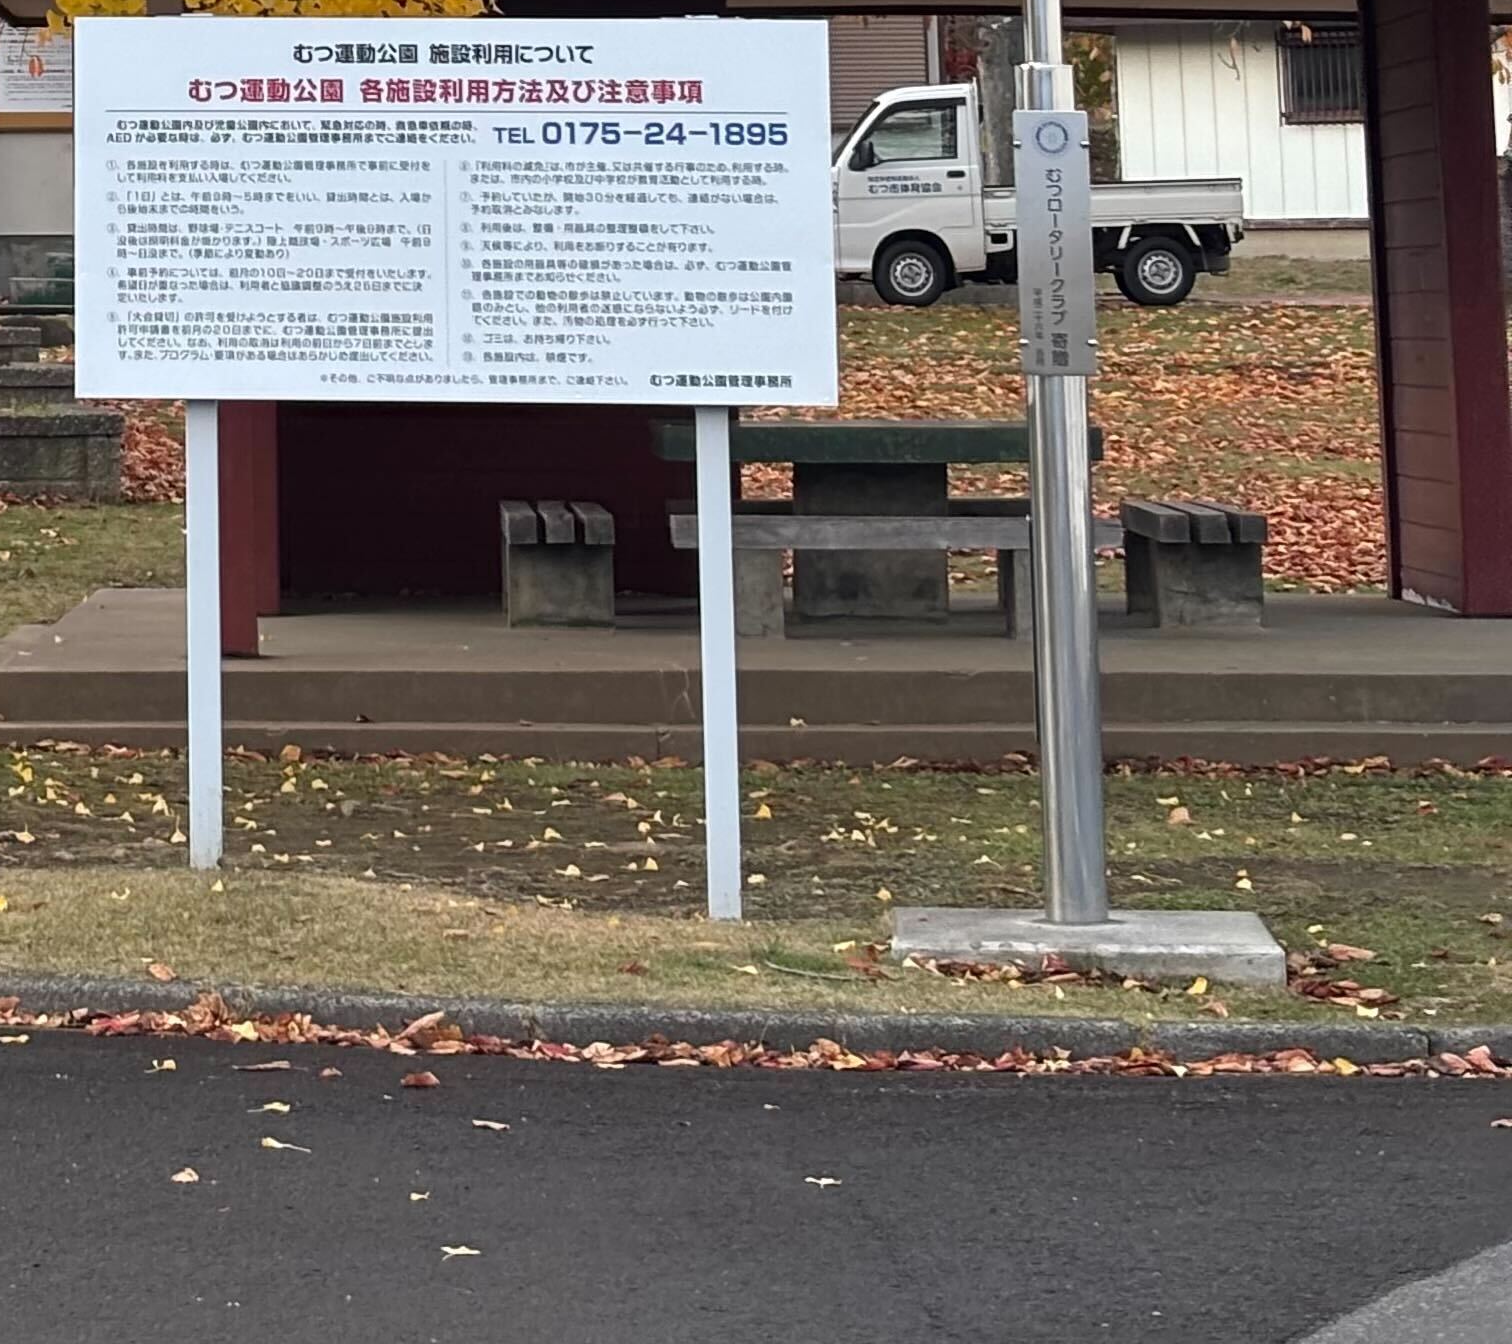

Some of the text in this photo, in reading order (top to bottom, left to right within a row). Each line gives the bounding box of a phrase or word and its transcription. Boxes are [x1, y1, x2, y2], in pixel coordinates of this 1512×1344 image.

[293, 43, 594, 64] むつ運動公園 施設利用について
[189, 78, 703, 104] むつ運動公園 各施設利用方法及び注意事項
[493, 122, 787, 145] TEL 0175-24-1895
[1045, 167, 1066, 326] むつロータリークラブ
[650, 374, 792, 388] むつ運動公園管理事務所
